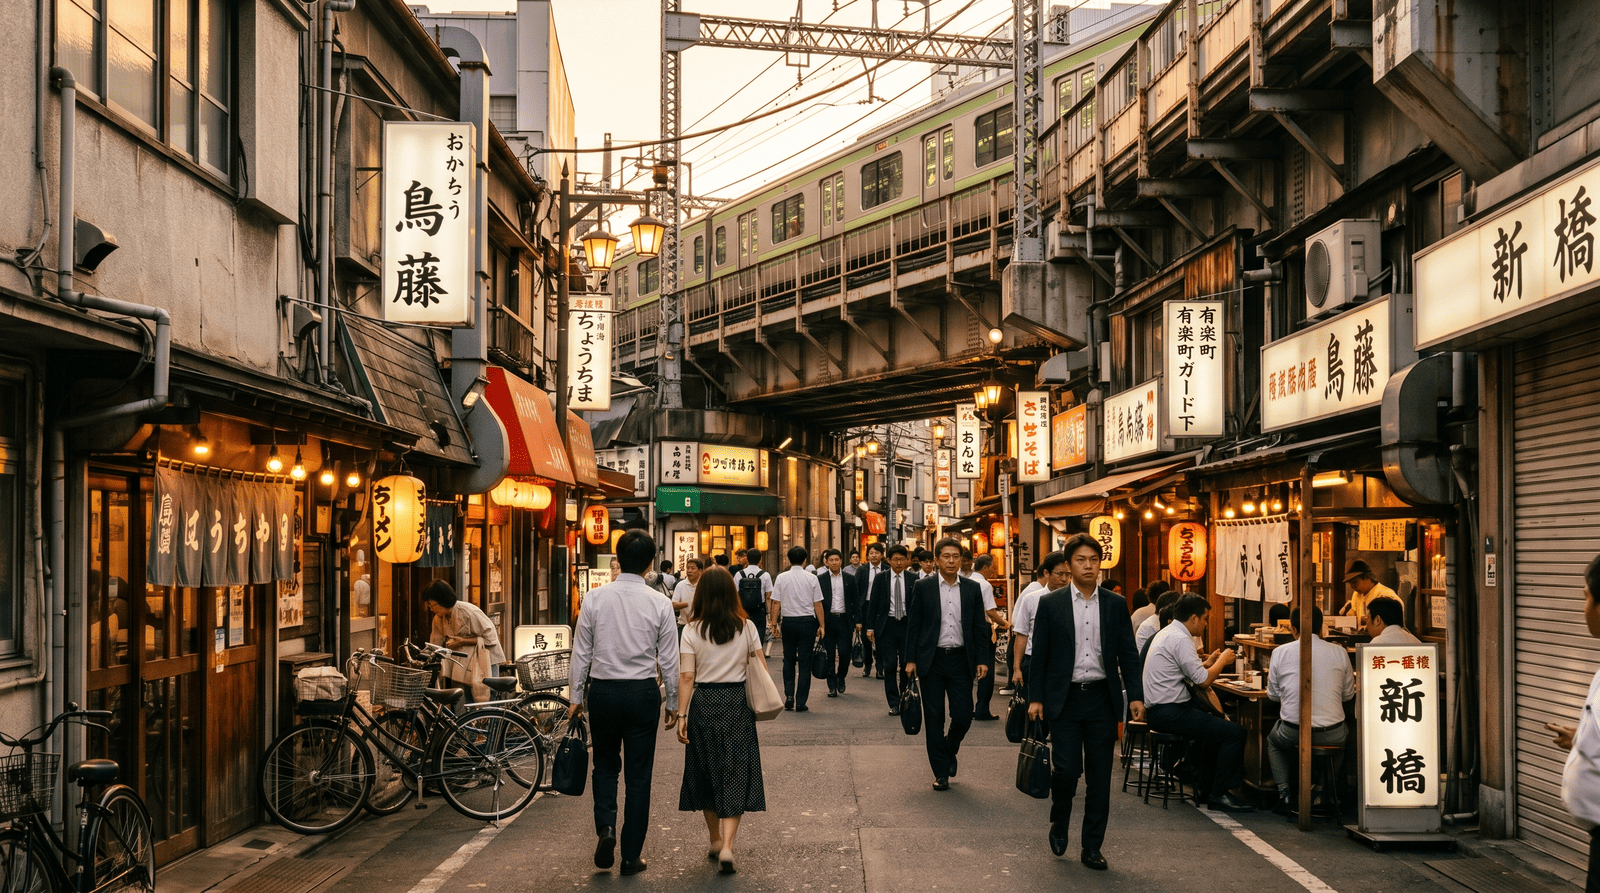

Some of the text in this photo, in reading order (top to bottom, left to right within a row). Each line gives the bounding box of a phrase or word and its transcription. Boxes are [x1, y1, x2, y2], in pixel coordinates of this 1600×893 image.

[393, 179, 449, 309] 鳥藤
[1491, 184, 1598, 304] 新橋
[1176, 305, 1196, 432] 有楽町ガード下
[1198, 305, 1217, 360] 有楽町
[1324, 319, 1378, 402] 鳥藤
[1378, 677, 1427, 795] 新橋
